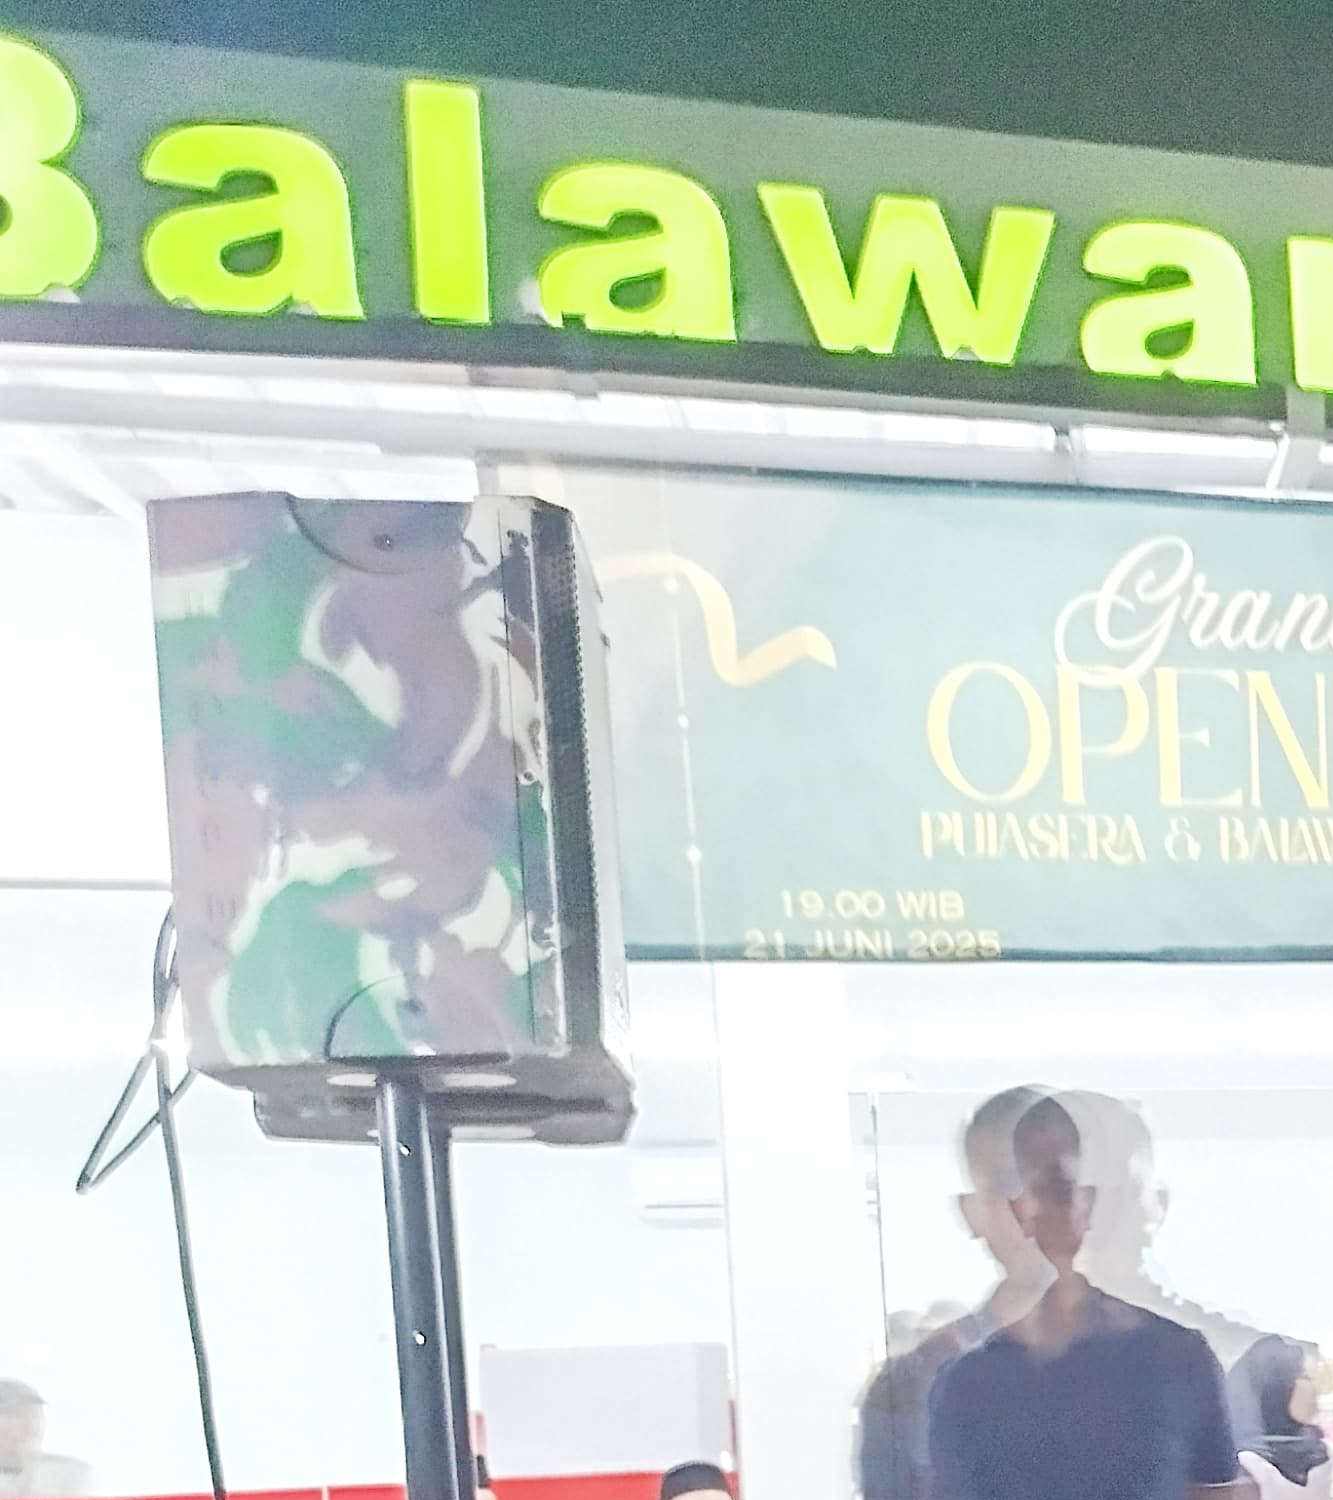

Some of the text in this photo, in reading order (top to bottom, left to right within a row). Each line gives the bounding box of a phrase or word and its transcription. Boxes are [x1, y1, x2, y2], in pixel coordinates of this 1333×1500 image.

[1164, 815, 1201, 863] &
[780, 889, 966, 921] 19.00 WIB
[743, 927, 1001, 960] 21 JUNI 2025
